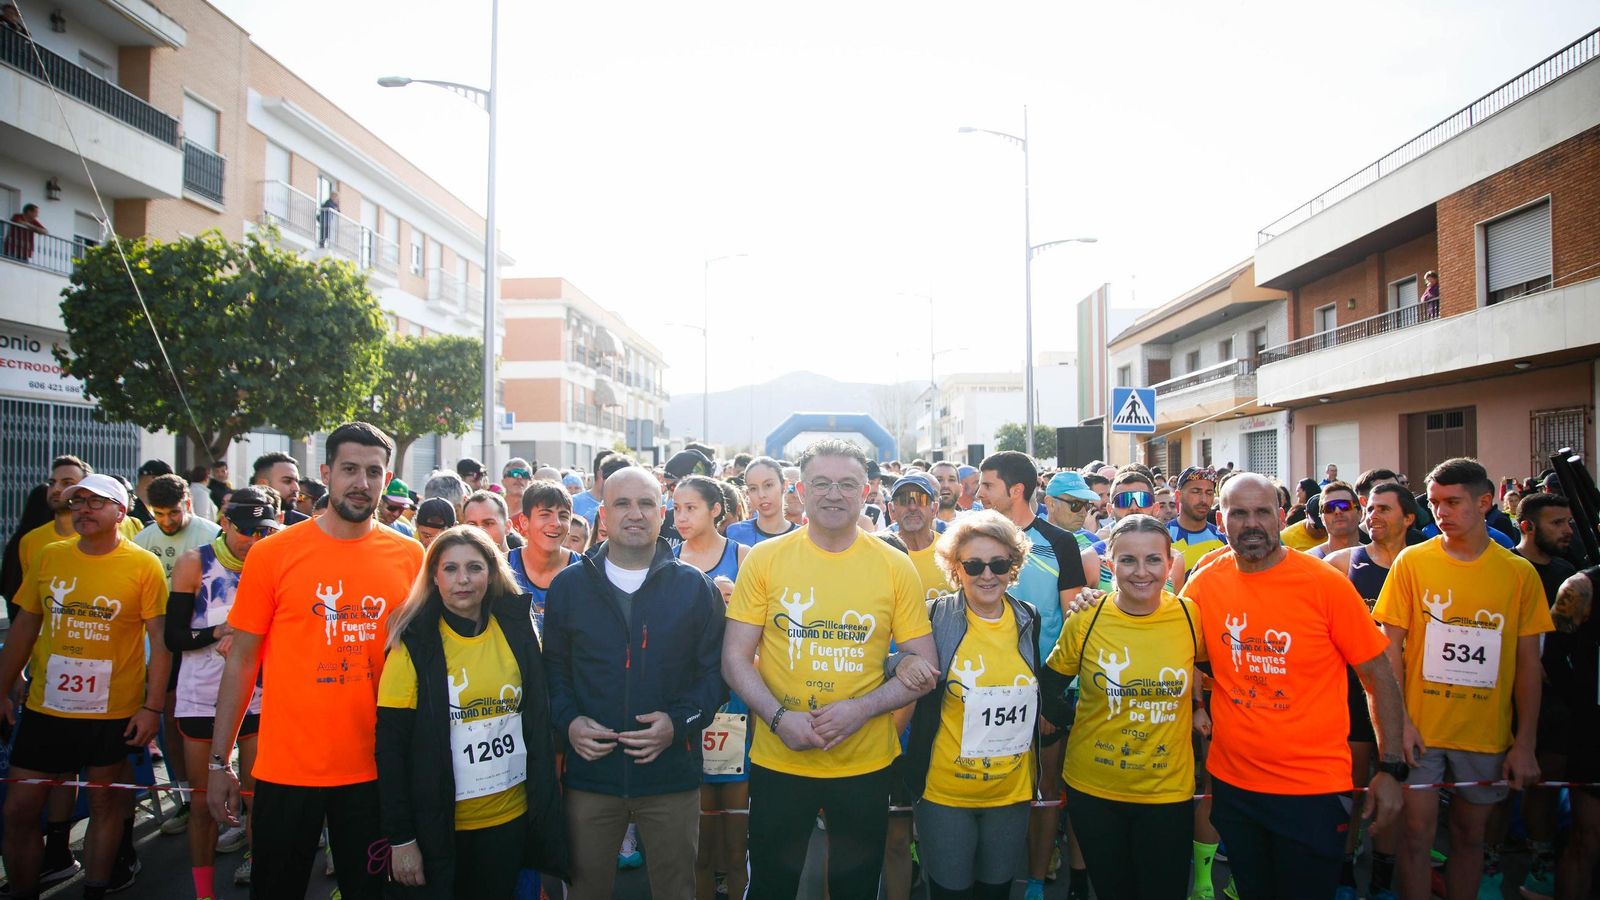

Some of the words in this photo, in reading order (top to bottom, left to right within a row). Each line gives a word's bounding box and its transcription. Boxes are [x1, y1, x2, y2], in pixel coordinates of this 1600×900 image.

[0, 335, 41, 353] onio
[0, 358, 65, 374] ECTRODO
[788, 628, 820, 639] CIUDAD
[823, 630, 835, 640] DE
[837, 631, 866, 641] BERJA
[1442, 642, 1486, 665] 534
[57, 673, 96, 693] 231
[806, 680, 835, 692] argar
[1105, 688, 1138, 697] CIUDAD
[1141, 688, 1153, 696] DE
[450, 708, 479, 720] IUDAD
[481, 706, 493, 716] DE
[981, 704, 1027, 727] 1541
[463, 734, 515, 764] 1269
[703, 731, 729, 751] 57
